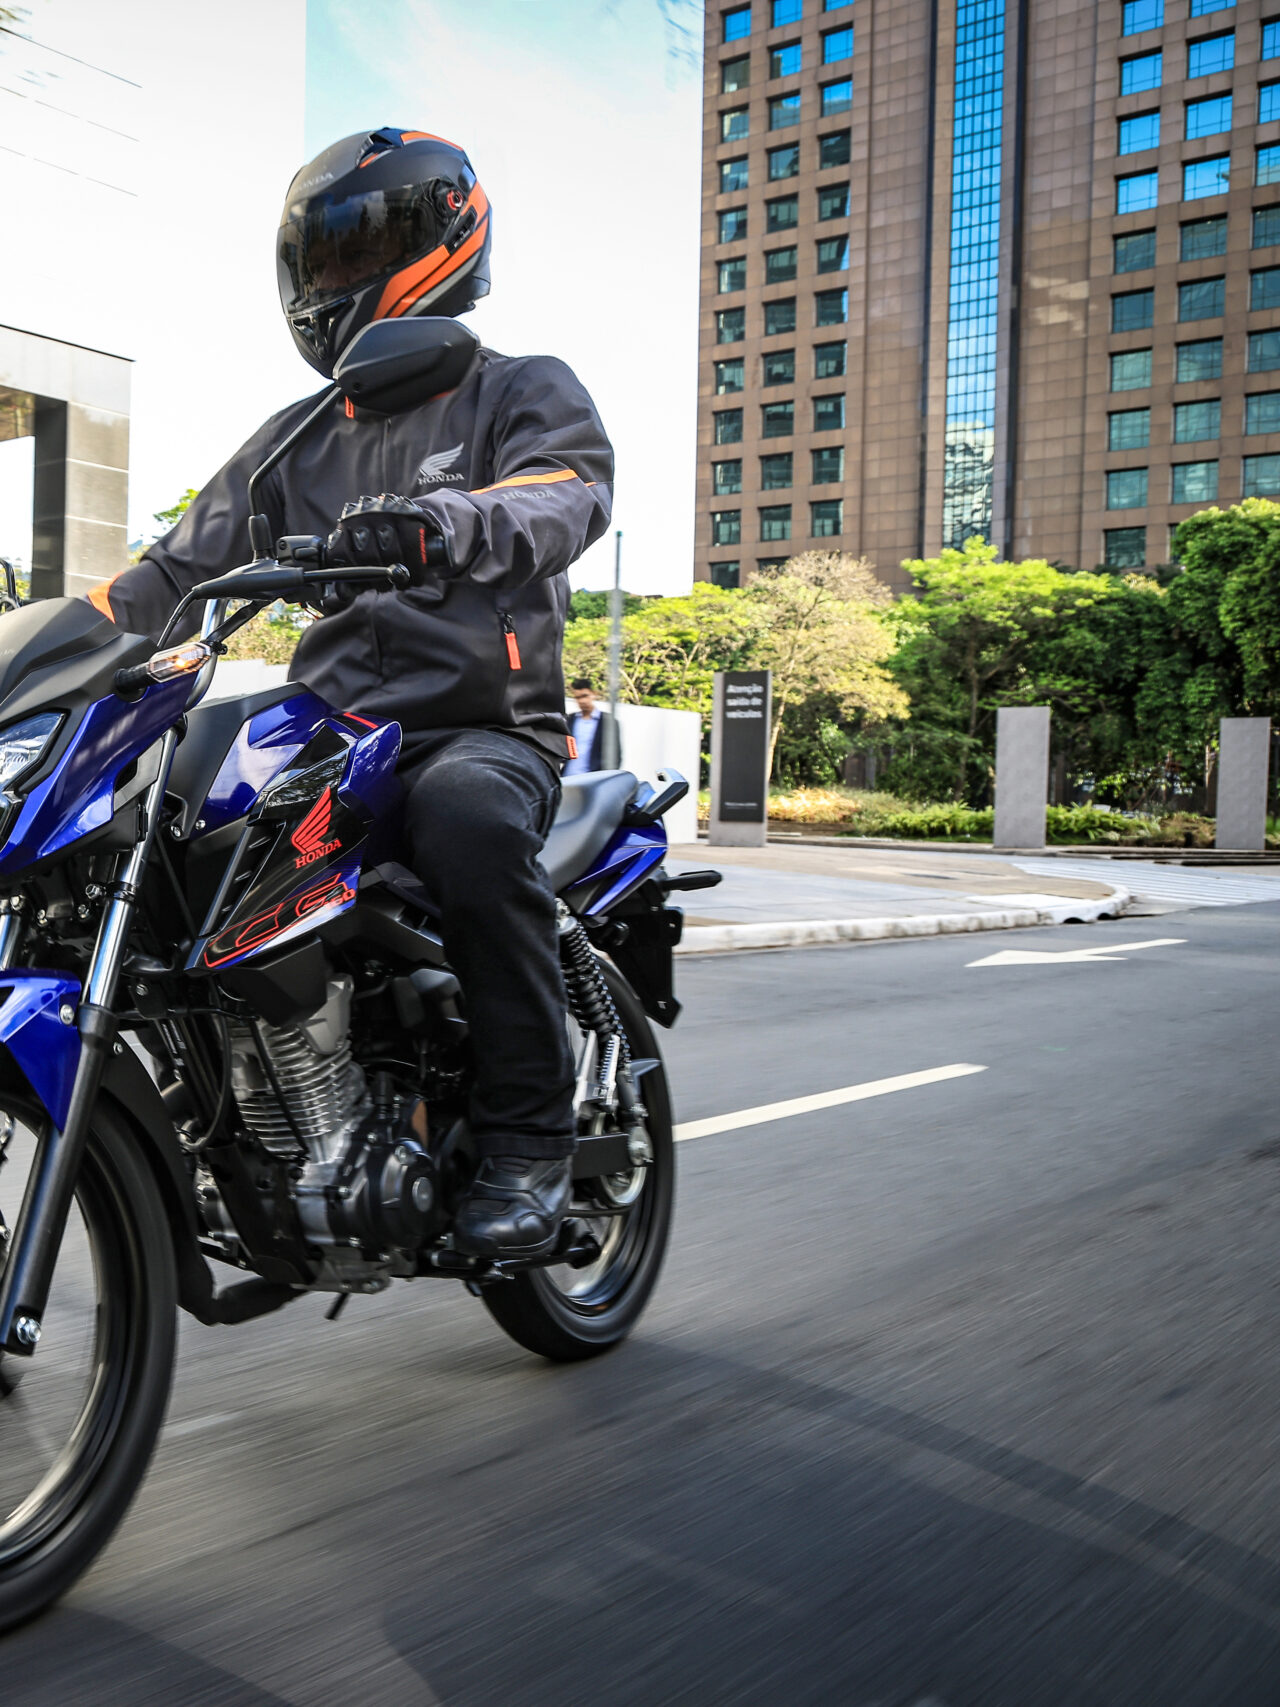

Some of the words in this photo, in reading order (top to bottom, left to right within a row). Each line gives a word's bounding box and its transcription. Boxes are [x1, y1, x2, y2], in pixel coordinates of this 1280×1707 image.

[418, 472, 465, 486] HONDA
[501, 489, 558, 501] HONDA
[295, 838, 342, 870] HONDA
